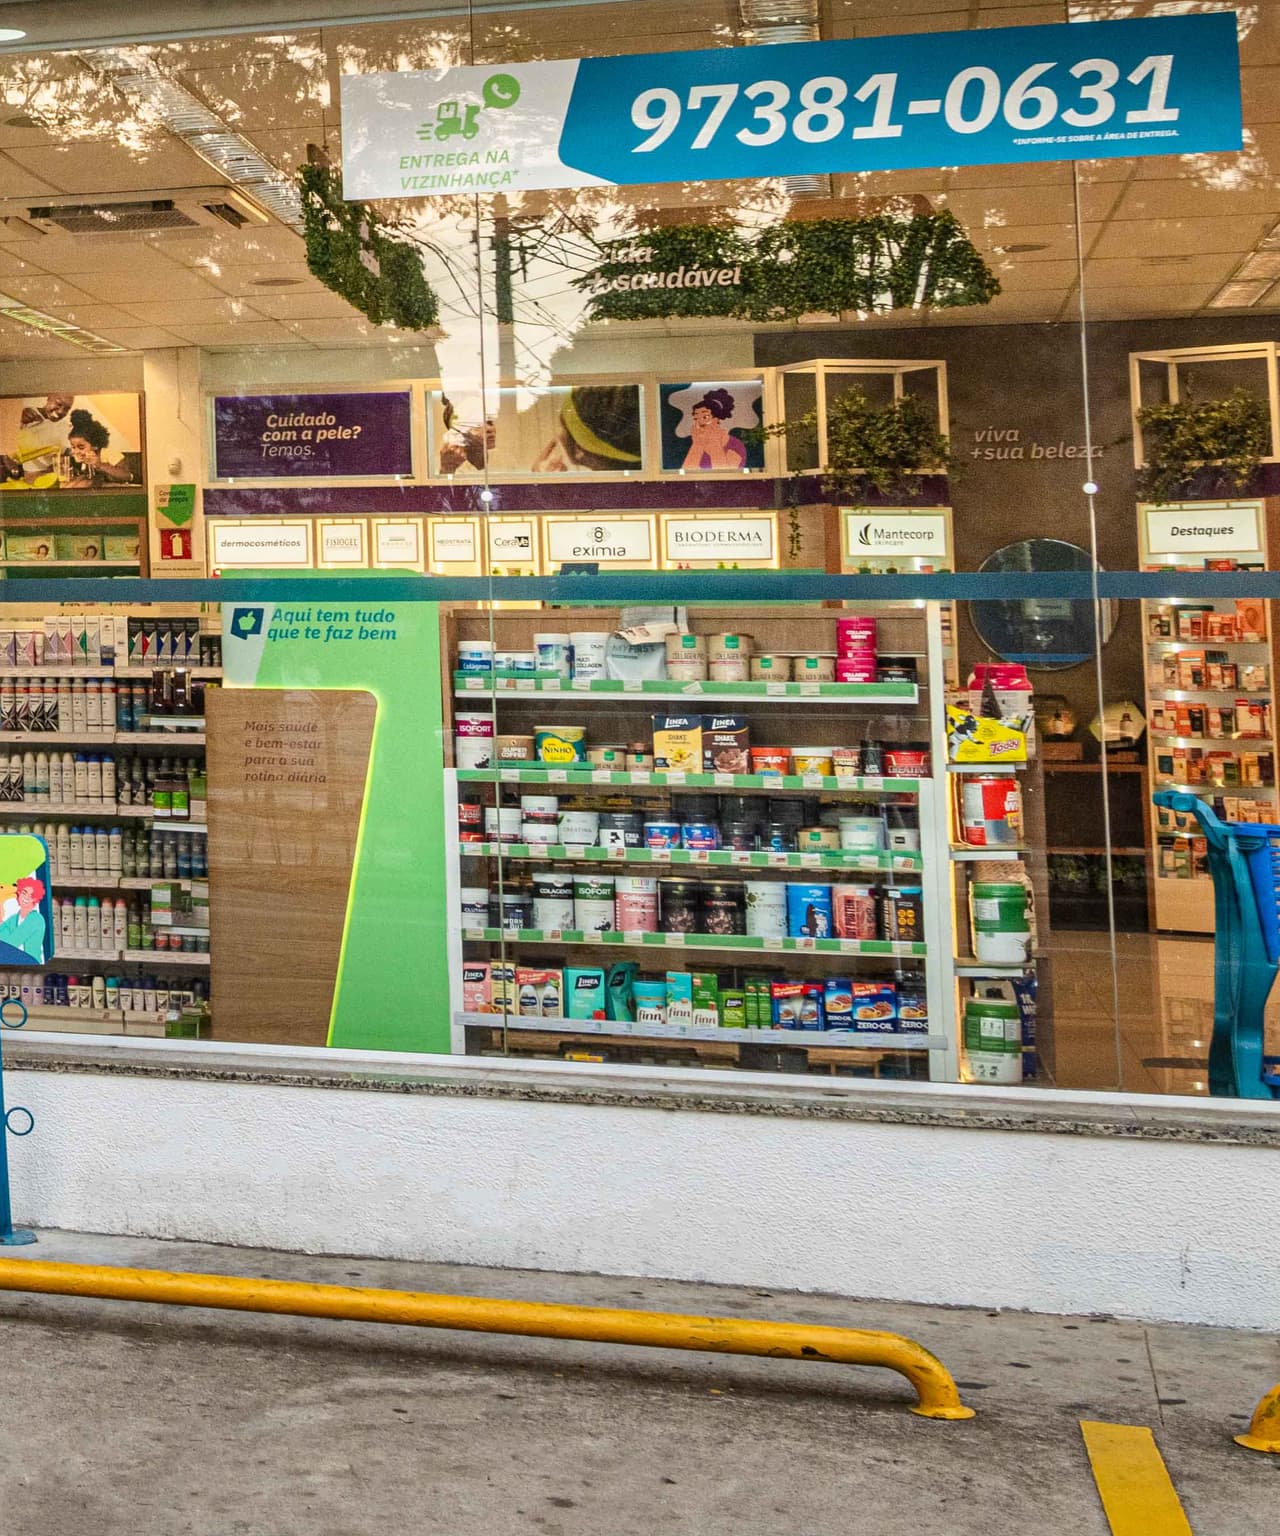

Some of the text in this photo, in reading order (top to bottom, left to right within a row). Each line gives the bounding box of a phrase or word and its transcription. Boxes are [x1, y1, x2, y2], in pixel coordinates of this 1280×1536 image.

[631, 55, 1180, 153] 97381-0631
[400, 150, 510, 169] ENTREGA NA
[267, 412, 336, 428] Cuidado
[262, 425, 362, 443] com a pele?
[974, 425, 1020, 443] viva
[260, 444, 316, 456] Temos.
[1030, 441, 1104, 460] beleza
[675, 531, 762, 542] BIODERMA
[873, 528, 934, 540] Mantecorp
[1171, 523, 1235, 538] Destaques
[221, 537, 301, 547] dermocosméticos
[494, 536, 529, 548] CeraVe
[271, 608, 396, 626] Aqui tem tudo
[267, 625, 397, 644] que te faz bem
[244, 720, 318, 732] Mais saúde
[244, 737, 322, 749] e bem-estar
[544, 746, 572, 754] NINHO
[244, 756, 314, 767] para a sua
[245, 770, 283, 782] rotina
[639, 1007, 662, 1021] finn
[669, 1006, 690, 1018] finn
[695, 1013, 717, 1025] finn
